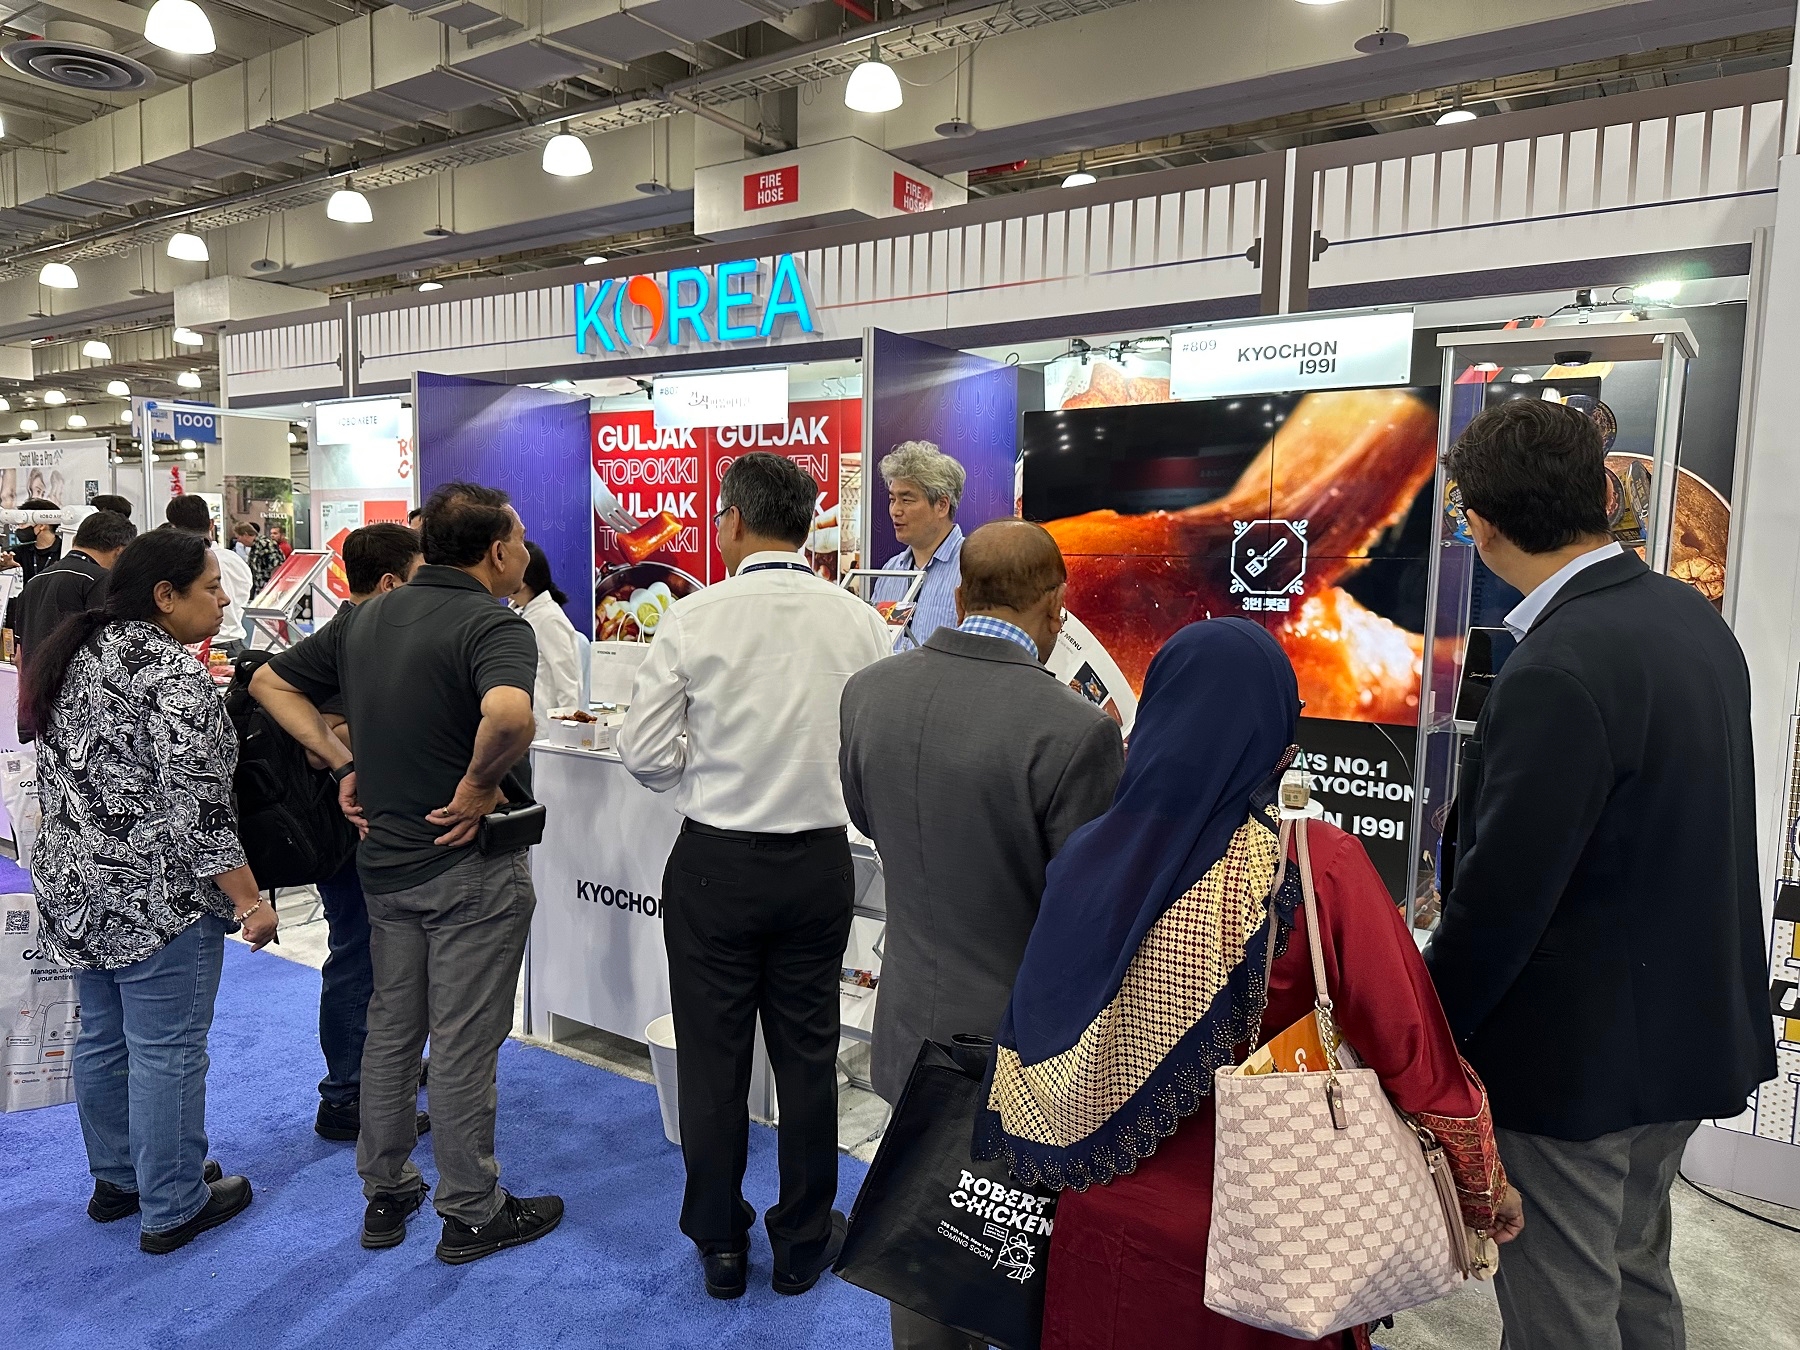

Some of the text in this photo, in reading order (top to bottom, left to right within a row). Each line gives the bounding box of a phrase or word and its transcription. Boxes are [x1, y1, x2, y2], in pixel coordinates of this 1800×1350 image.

[760, 172, 782, 190] FIRE
[905, 181, 922, 198] FIRE
[757, 187, 784, 205] HOSE
[574, 253, 813, 354] KOREA
[1182, 340, 1217, 352] #809
[1238, 340, 1338, 362] KYOCHON
[1298, 358, 1336, 375] 1991
[176, 414, 214, 428] 1000
[716, 416, 830, 448] GULJAK
[598, 424, 698, 452] GULJAK
[19, 452, 30, 466] Send
[32, 451, 39, 466] Me
[44, 451, 53, 466] Pro
[598, 457, 698, 486] TOPOKKI
[613, 492, 698, 518] ULJAK
[1242, 597, 1262, 611] 3번
[1064, 633, 1082, 651] MENU
[1334, 756, 1388, 778] NO.1
[1352, 815, 1404, 840] 1991
[958, 1169, 1050, 1215] ROBERT
[949, 1190, 1054, 1236] CHICKEN
[938, 1226, 968, 1247] COMING
[969, 1245, 991, 1260] SOON
[982, 1244, 994, 1253] York
